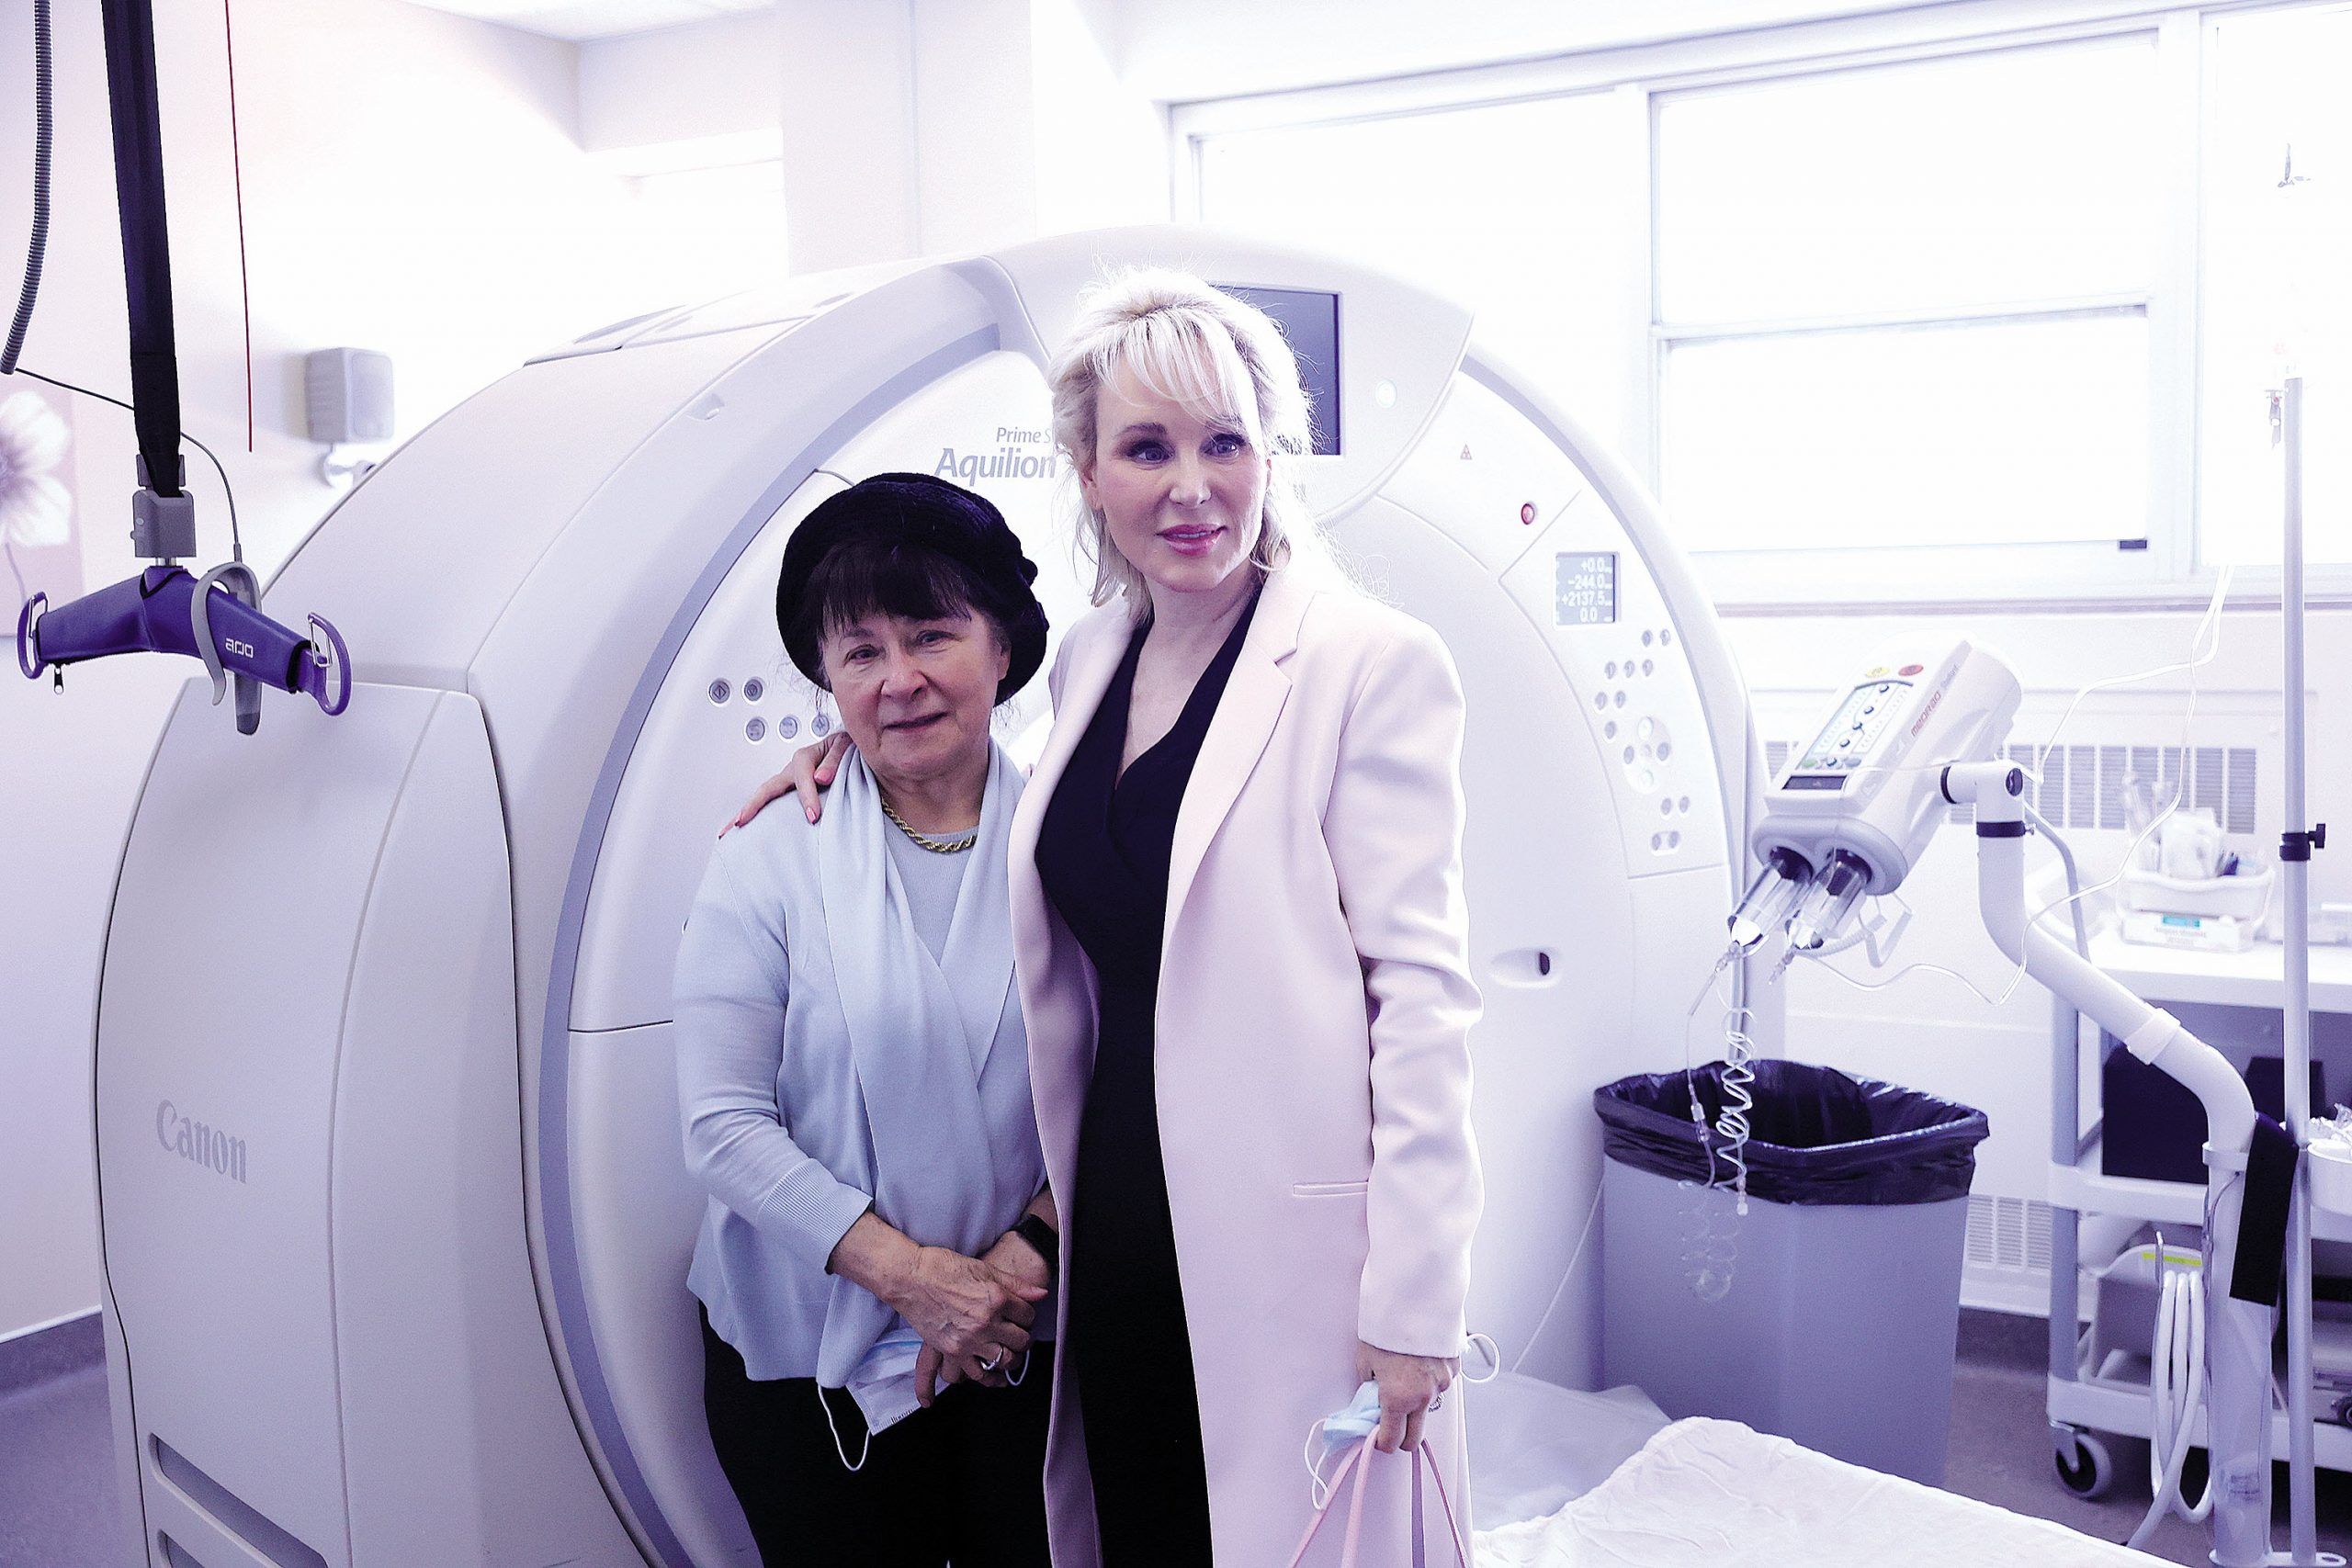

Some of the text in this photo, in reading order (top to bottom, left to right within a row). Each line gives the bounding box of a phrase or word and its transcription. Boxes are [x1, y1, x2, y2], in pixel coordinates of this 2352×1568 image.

[996, 426, 1051, 443] Prime S
[933, 447, 1057, 487] Aquilion
[156, 1100, 246, 1184] Canon
